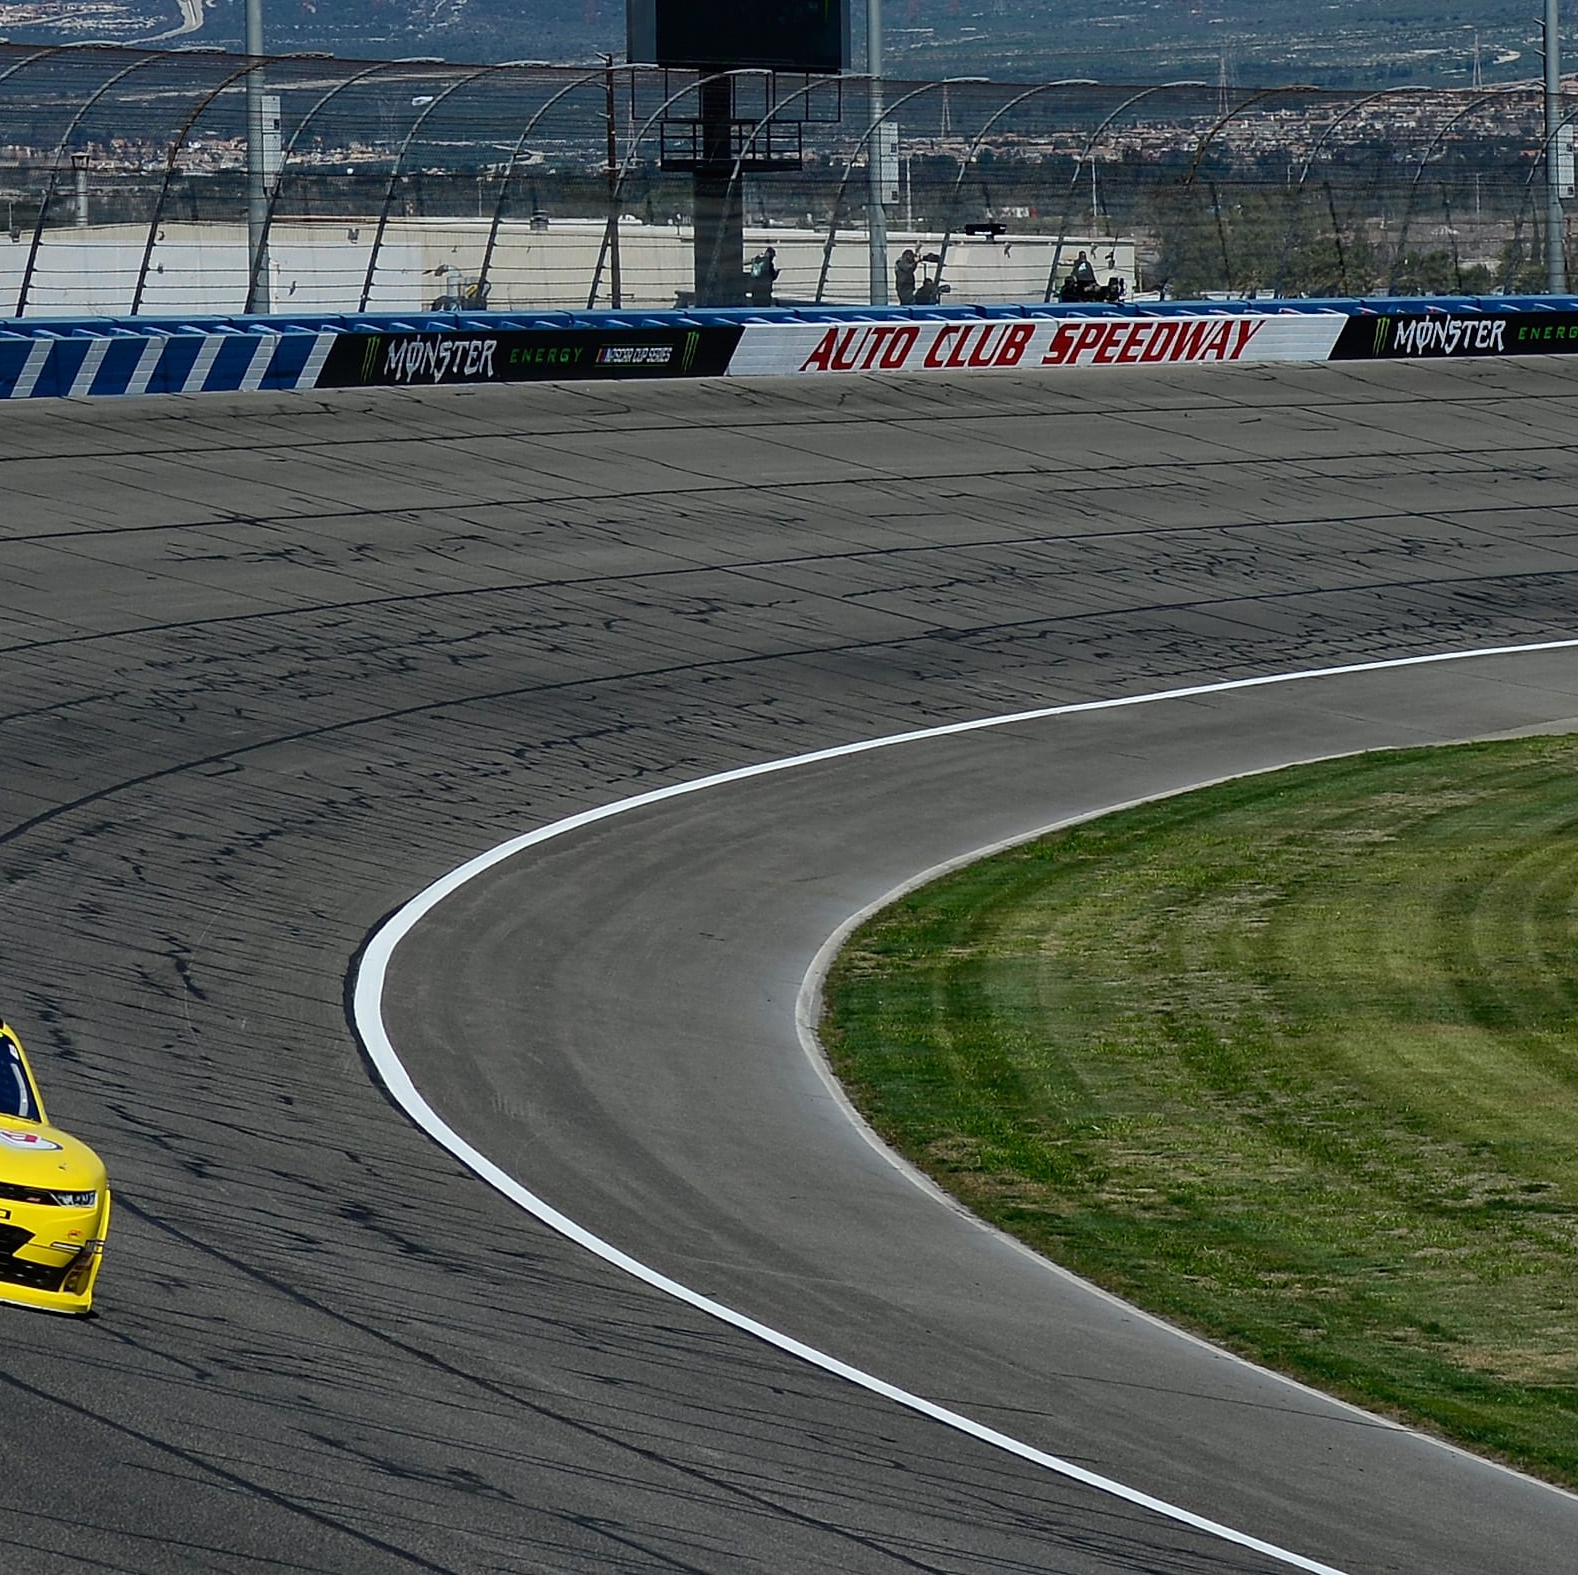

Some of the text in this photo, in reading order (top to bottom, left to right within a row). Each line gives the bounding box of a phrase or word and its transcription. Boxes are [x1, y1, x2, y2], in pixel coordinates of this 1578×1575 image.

[383, 333, 584, 384] MONSTER ENERGY
[798, 319, 1267, 372] AUTO CLUB SPEEDWAY
[1393, 313, 1507, 355] MONSTER
